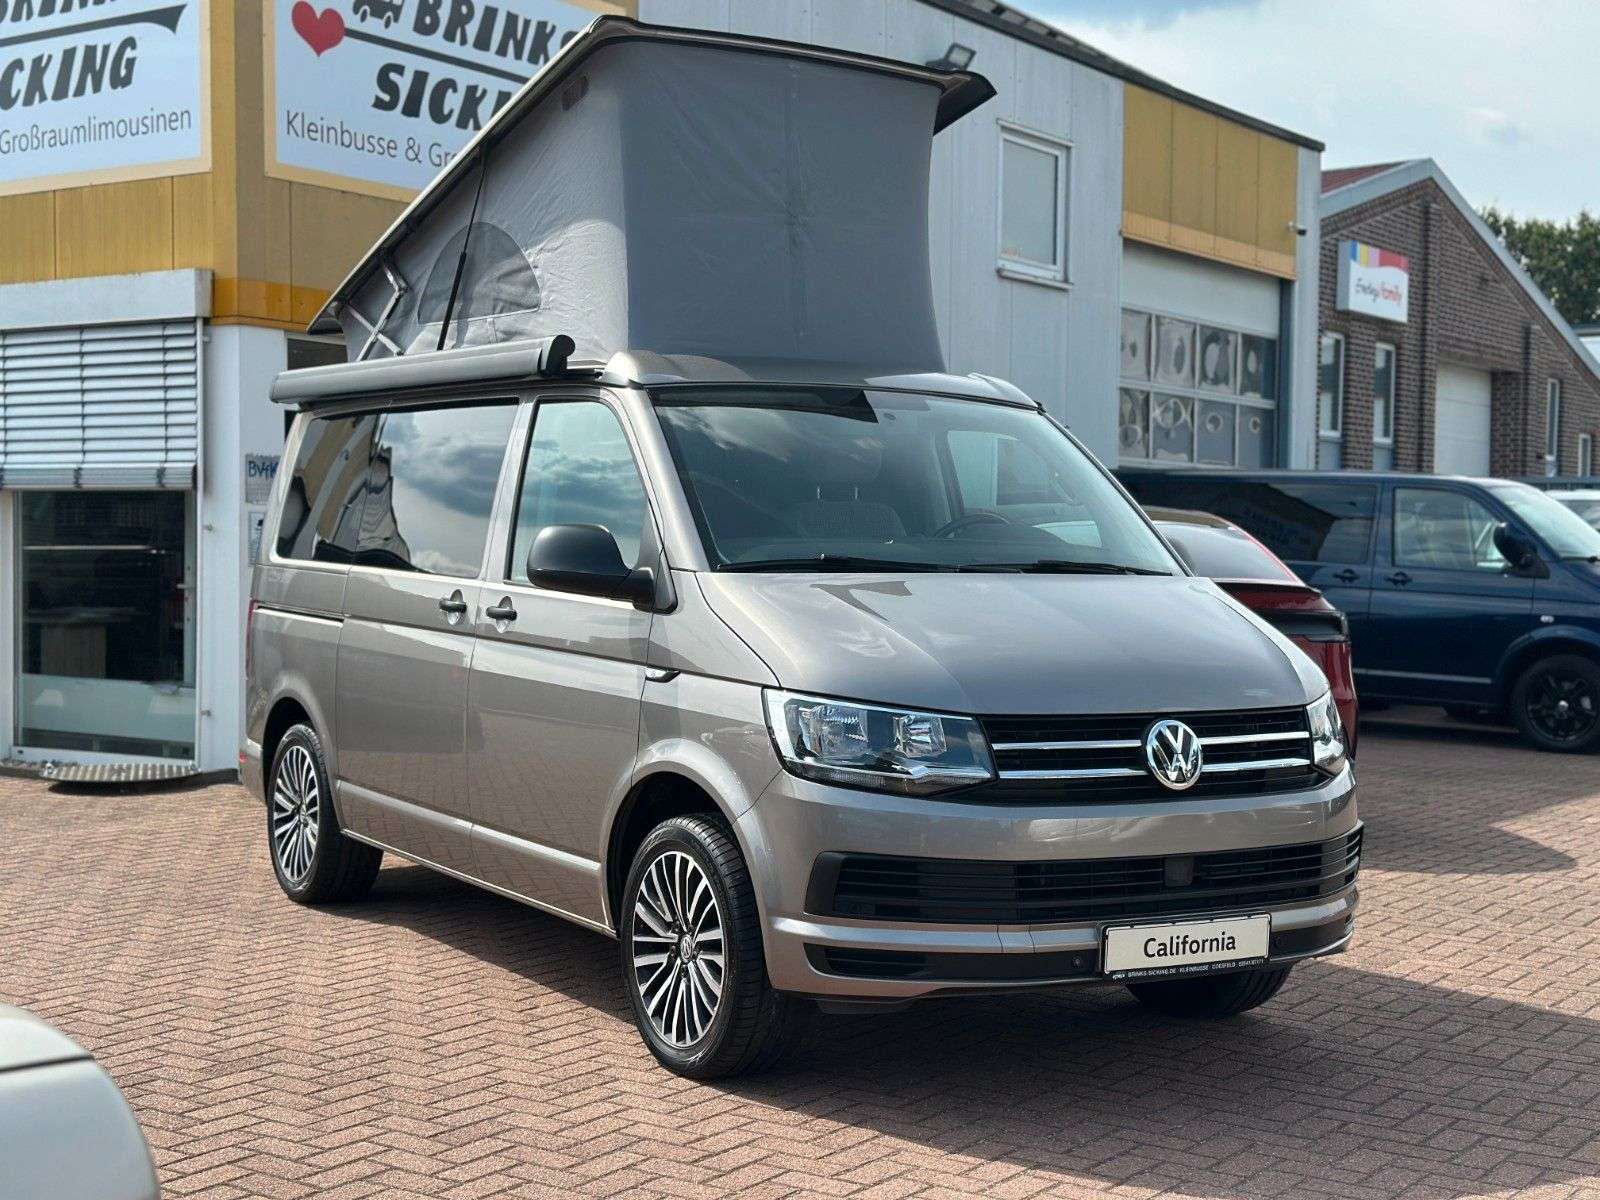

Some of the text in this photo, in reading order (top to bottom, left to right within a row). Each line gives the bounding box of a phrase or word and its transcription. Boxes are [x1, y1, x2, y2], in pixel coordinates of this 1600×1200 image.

[0, 36, 137, 111] CKING
[0, 108, 192, 154] Großraumlimousinen
[286, 110, 458, 168] Kleinbusse & Gr
[1143, 931, 1237, 958] California
